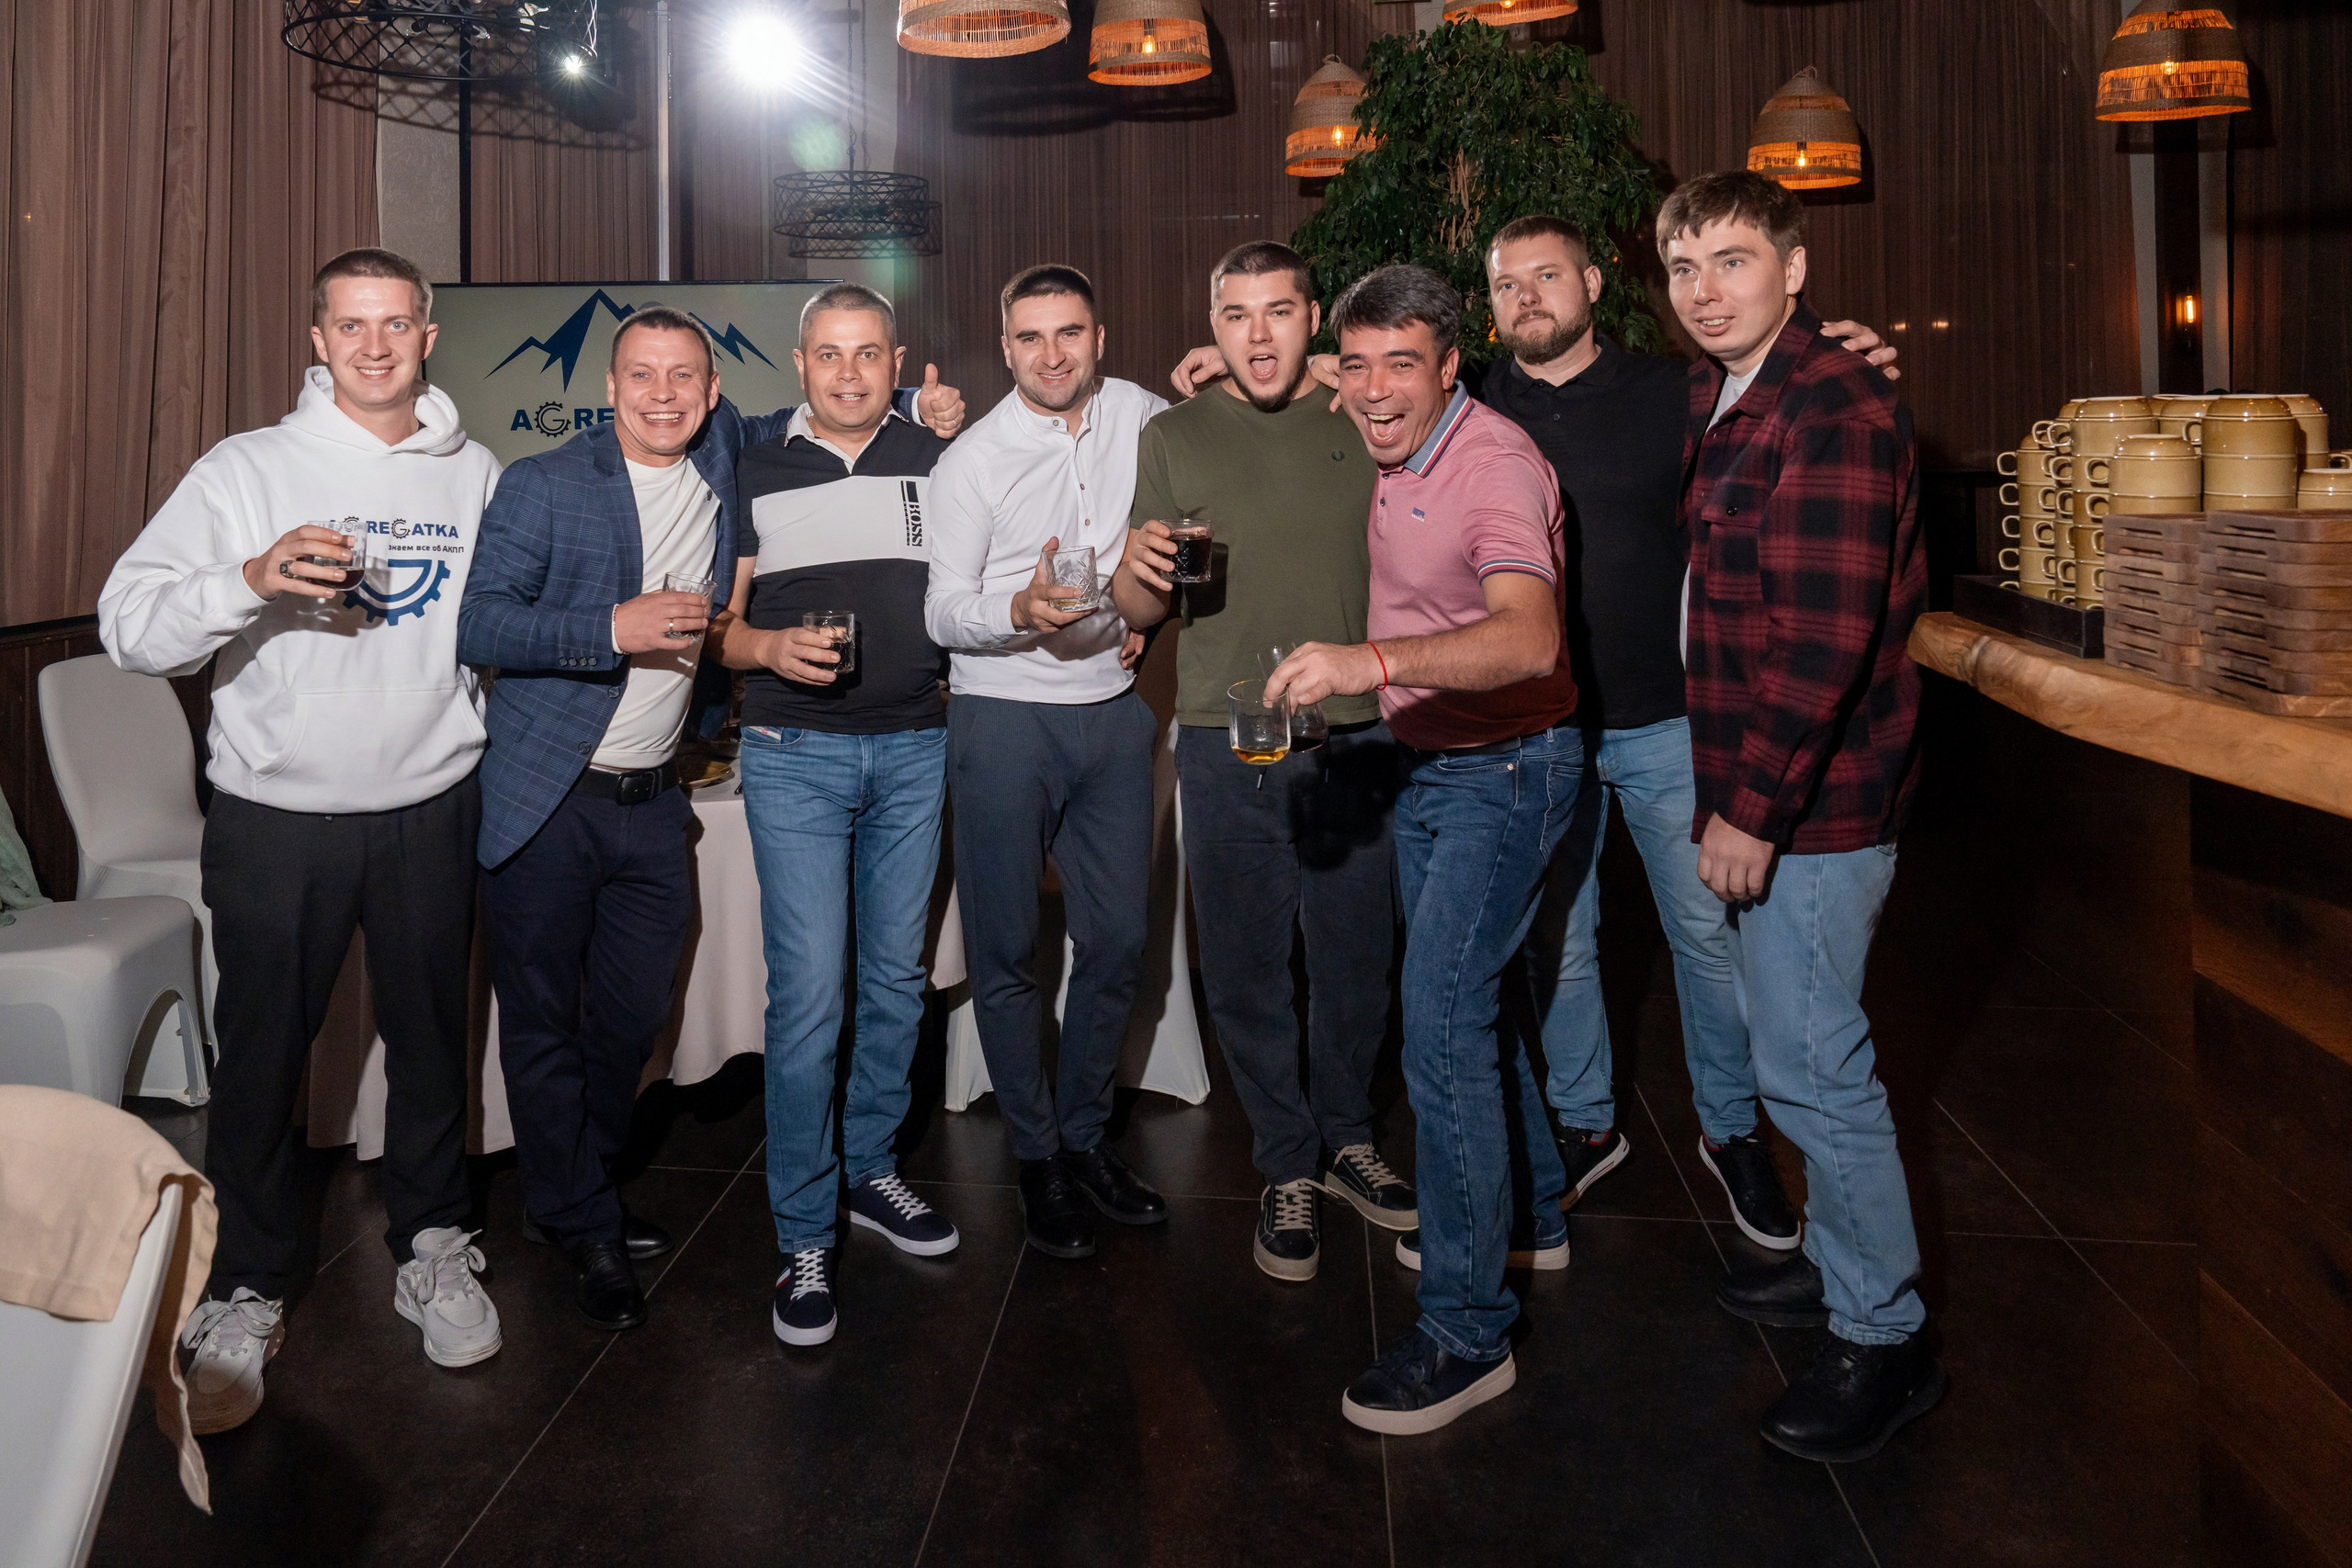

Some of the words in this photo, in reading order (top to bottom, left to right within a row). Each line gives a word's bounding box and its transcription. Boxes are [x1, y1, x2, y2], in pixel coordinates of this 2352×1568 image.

[510, 401, 615, 437] AGRE
[330, 516, 459, 540] REGATKA
[909, 502, 922, 547] BOSS
